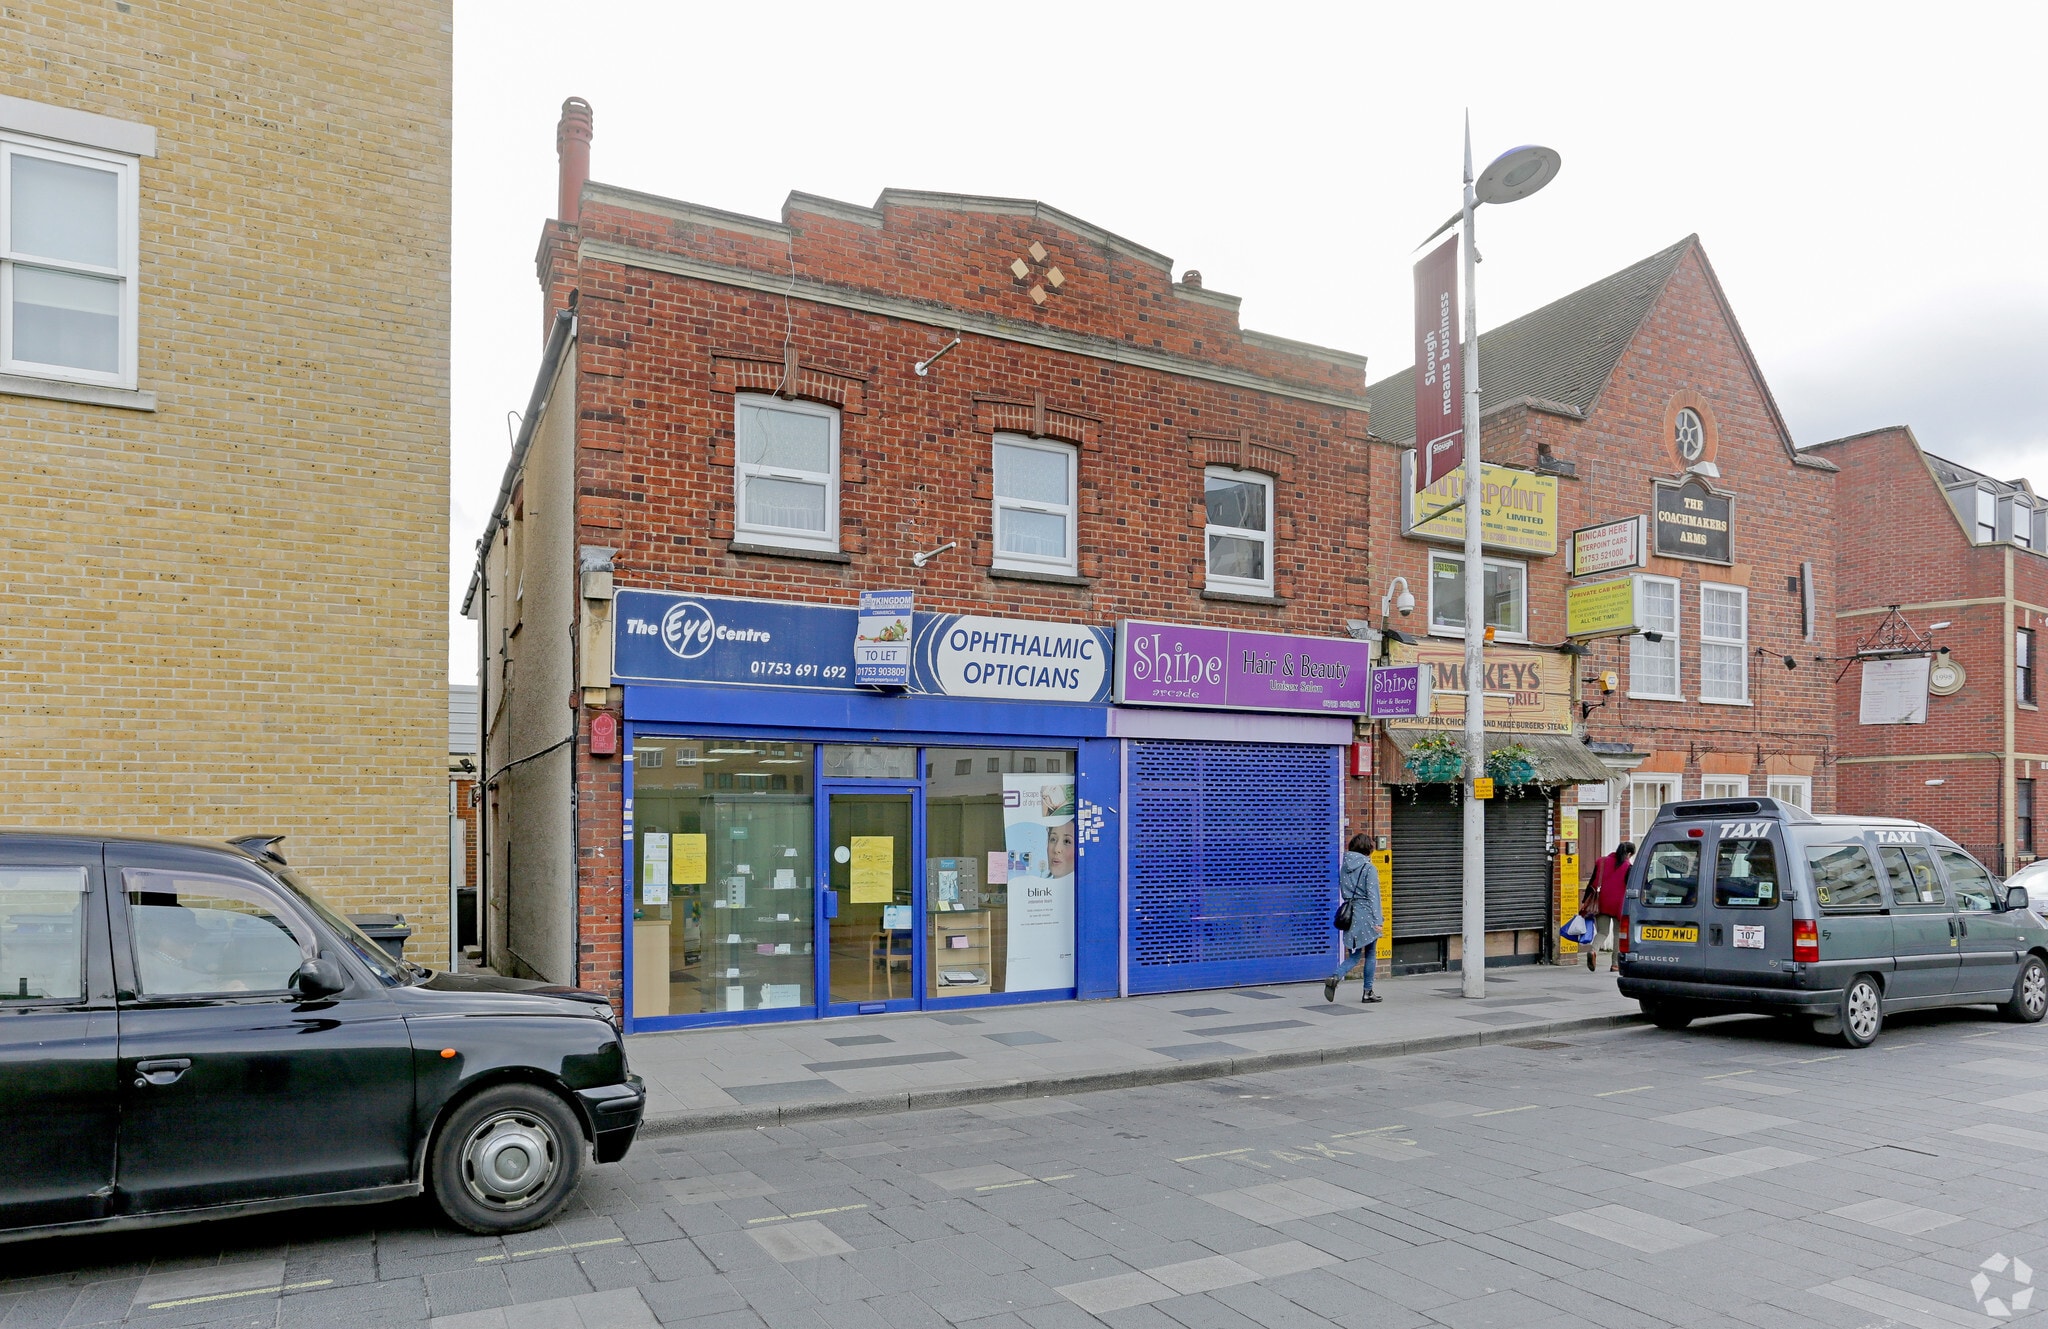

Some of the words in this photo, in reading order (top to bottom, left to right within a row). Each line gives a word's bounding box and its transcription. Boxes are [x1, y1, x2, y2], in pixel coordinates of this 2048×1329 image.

[1439, 291, 1451, 361] business
[1424, 330, 1437, 386] Slough
[1442, 362, 1452, 415] means
[1433, 439, 1454, 451] Slough
[1683, 497, 1704, 511] THE
[1506, 512, 1544, 525] LIMITED
[1658, 510, 1727, 532] COACHMAKERS
[1577, 528, 1607, 542] MINICAB
[1608, 524, 1628, 535] HERE
[1680, 531, 1707, 545] ARMS
[1577, 540, 1611, 553] INTERPOINT
[1611, 536, 1628, 545] CARS
[1580, 553, 1599, 564] 01753
[1600, 548, 1624, 560] 521000
[1592, 562, 1610, 570] BUZZER
[1610, 559, 1627, 567] BELOW
[876, 596, 912, 605] KINGDOM
[1573, 590, 1597, 598] PRIVATE
[627, 618, 658, 636] The
[665, 608, 710, 655] Eye
[716, 625, 771, 643] Centre
[950, 628, 1094, 660] OPHTHALMIC
[866, 650, 878, 661] TO
[880, 650, 897, 661] LET
[1132, 634, 1222, 685] Shine
[750, 660, 792, 676] 01753
[795, 663, 819, 678] 691
[822, 665, 847, 679] 692
[857, 667, 876, 677] 01753
[878, 667, 905, 677] 903809
[963, 661, 1080, 690] OPTICIANS
[1241, 650, 1277, 675] Hair
[1281, 653, 1295, 678] &
[1300, 654, 1350, 687] Beauty
[1269, 679, 1298, 692] Unisex
[1299, 681, 1324, 693] Salon
[1374, 670, 1417, 693] Shine
[1152, 688, 1200, 699] arcade
[1394, 697, 1412, 706] Beauty
[1377, 706, 1395, 714] Unisex
[1395, 705, 1410, 713] Salon
[1497, 721, 1516, 729] MADE
[1517, 722, 1545, 730] BURGERS
[1547, 722, 1569, 731] STEAKS
[1022, 790, 1040, 799] Escape
[1719, 822, 1773, 839] TAXI
[1874, 830, 1917, 843] TAXI
[1027, 887, 1052, 897] blink
[1645, 928, 1670, 939] SD07
[1672, 929, 1693, 940] MWU
[1740, 931, 1755, 940] 107
[1638, 955, 1680, 963] PEUGEOT
